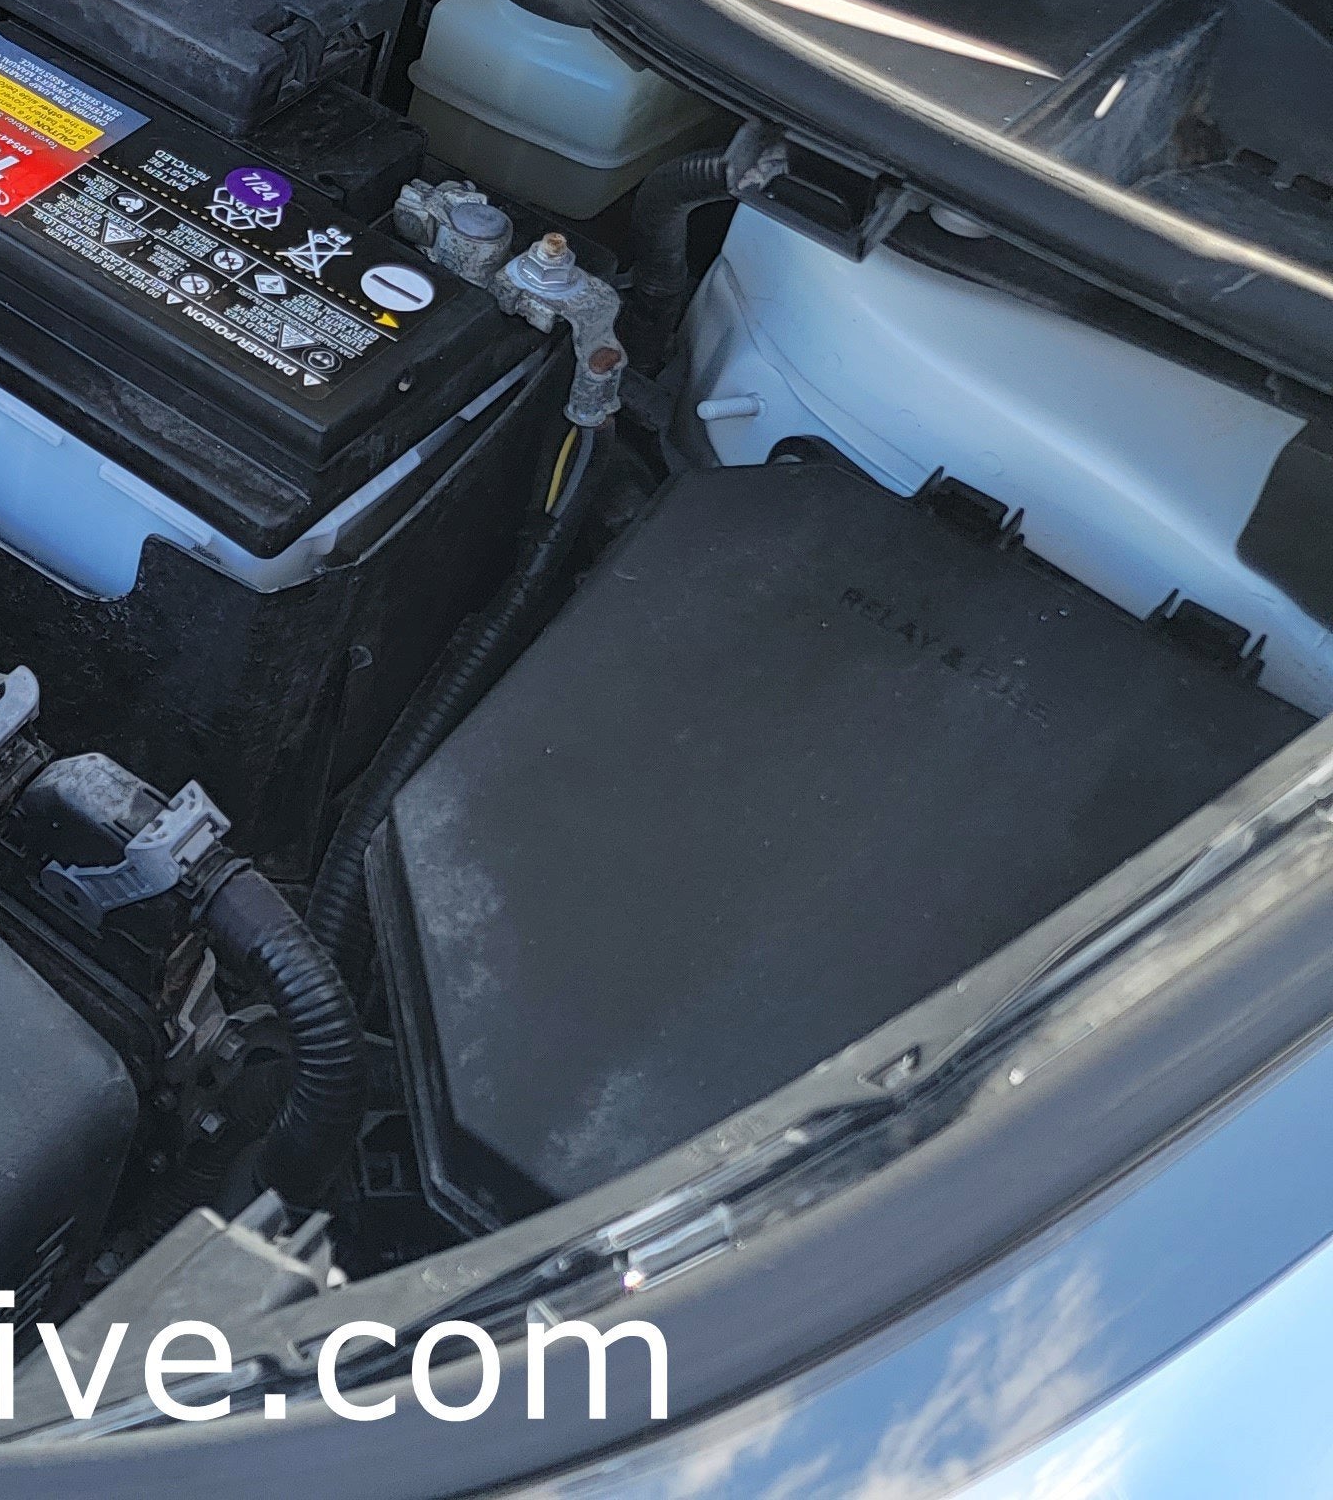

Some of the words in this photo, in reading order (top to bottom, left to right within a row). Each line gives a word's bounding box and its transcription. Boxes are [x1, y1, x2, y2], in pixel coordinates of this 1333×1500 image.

[26, 80, 55, 96] JUMP
[65, 85, 103, 105] SERVICE
[16, 91, 39, 104] side
[49, 93, 72, 107] FOR
[69, 95, 106, 116] VEHICLE
[23, 104, 60, 125] battery
[36, 103, 64, 119] other
[98, 102, 123, 116] SEEK
[1, 115, 31, 132] Motor
[55, 123, 74, 134] the
[62, 117, 80, 128] the
[27, 129, 60, 149] Toyota
[152, 148, 211, 182] RECYCLED
[137, 162, 189, 192] BATTERY
[162, 164, 199, 186] MUST
[82, 185, 107, 200] READ
[241, 172, 280, 202] 7/24
[40, 201, 63, 215] ACID
[54, 200, 82, 217] CAUSE
[55, 192, 103, 221] BLINDNESS
[59, 212, 99, 237] SULFURIC
[78, 214, 101, 229] CAN
[102, 210, 134, 230] SEVERE
[53, 222, 77, 238] AND
[164, 232, 184, 245] OUT
[72, 234, 104, 254] TIGHT
[181, 234, 212, 253] REACH
[181, 242, 206, 257] KEEP
[77, 246, 103, 263] OPEN
[99, 250, 124, 266] CAPS
[112, 268, 130, 279] TIP
[119, 262, 146, 280] VENT
[125, 275, 148, 291] NOT
[141, 276, 168, 294] KEEP
[231, 303, 279, 333] EXPLOSIVE
[249, 305, 281, 325] GASES
[271, 308, 315, 335] BLINDNESS
[320, 304, 360, 329] MEDICAL
[321, 314, 347, 330] WITH
[244, 321, 277, 342] SHIELD
[314, 318, 339, 334] EYES
[356, 325, 380, 341] GET
[181, 304, 297, 377] DANGER/POISON
[312, 332, 339, 349] CAUSE
[335, 331, 367, 350] FLUSH
[345, 327, 373, 345] ATELY
[336, 346, 355, 359] CAN
